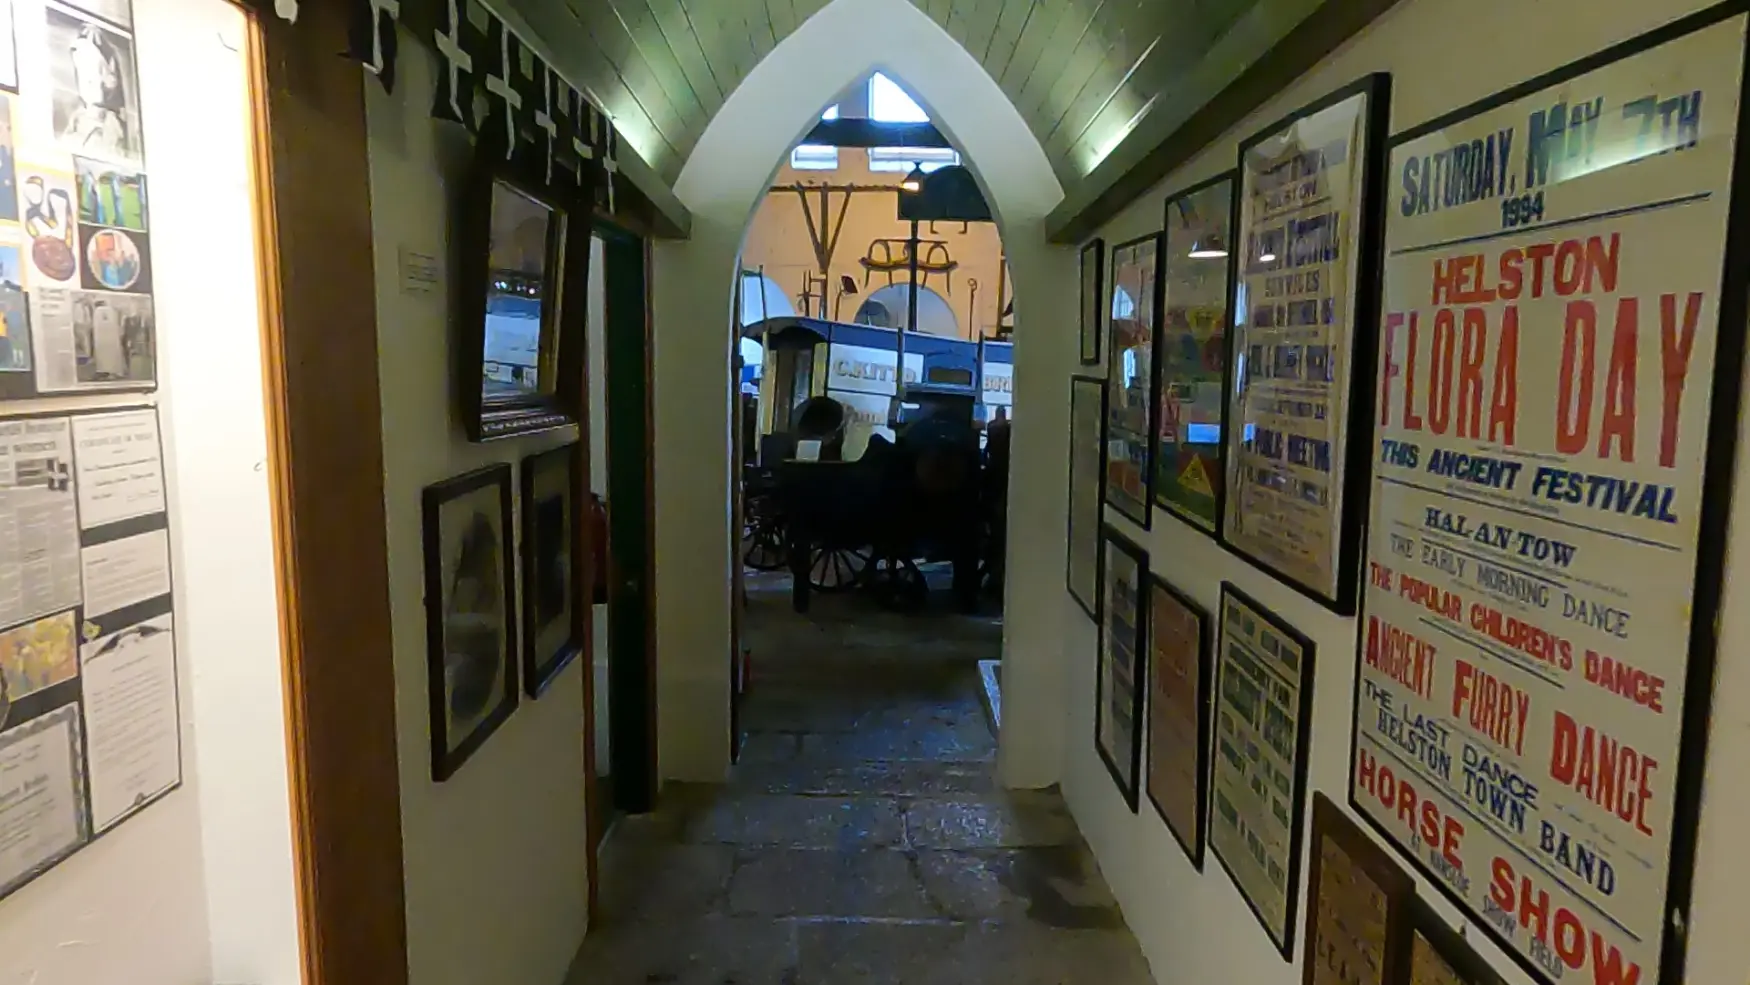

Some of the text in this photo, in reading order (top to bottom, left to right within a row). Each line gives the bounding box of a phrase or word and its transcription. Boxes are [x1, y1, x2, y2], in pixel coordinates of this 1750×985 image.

[1432, 232, 1621, 306] HELSTON
[1501, 191, 1545, 227] 1994
[1380, 292, 1704, 468] FLORA DAY
[1380, 439, 1419, 468] THIS
[1426, 453, 1522, 491] ANCIENT
[1532, 467, 1678, 524] FESTIVAL
[1370, 562, 1392, 590] THE
[1399, 571, 1461, 624] POPULAR
[1470, 603, 1573, 670] CHILDREN'S
[1585, 652, 1665, 714] DANCE
[1391, 533, 1414, 560] THE
[1422, 545, 1466, 578] EARLY
[1477, 563, 1549, 608] MORNING
[1563, 593, 1630, 639] DANCE
[1364, 679, 1393, 711] THE
[1404, 704, 1449, 747] LAST
[1461, 743, 1539, 803] DANCE
[1366, 615, 1436, 701] ANCIENT
[1452, 659, 1529, 757] FURRY
[1550, 710, 1658, 837] DANCE
[1360, 748, 1466, 869] HORSE
[1489, 857, 1642, 985] SHOW
[1376, 711, 1452, 782] HELSTON
[1462, 767, 1526, 834] TOWN
[1540, 820, 1615, 896] BAND
